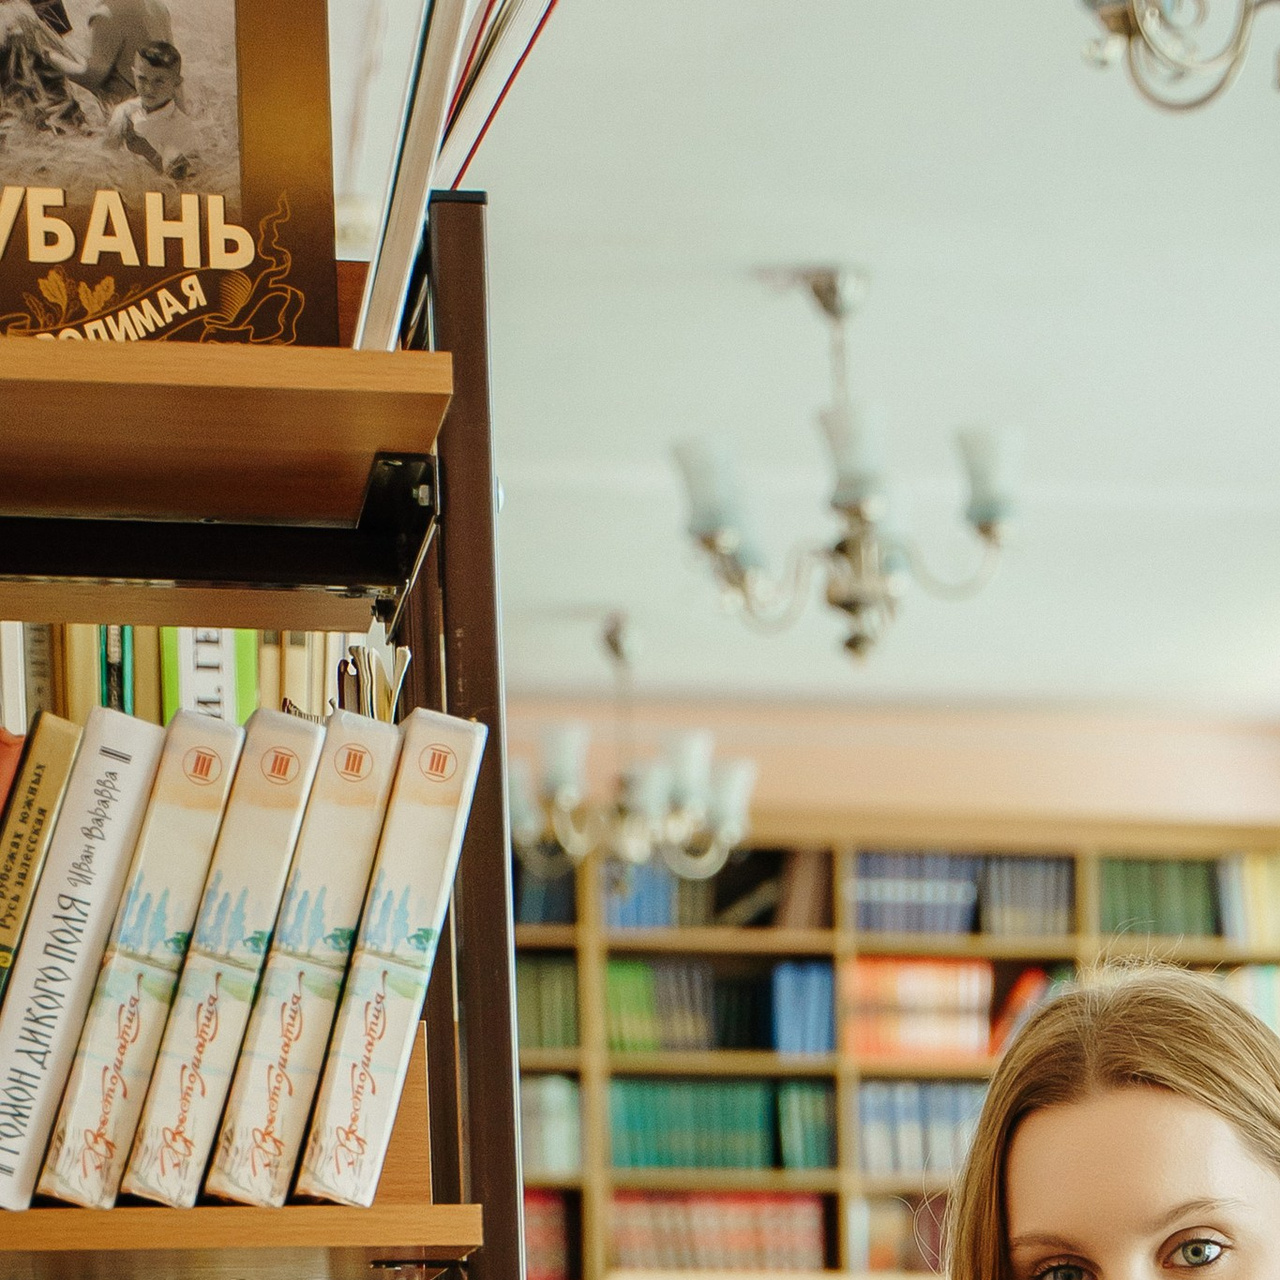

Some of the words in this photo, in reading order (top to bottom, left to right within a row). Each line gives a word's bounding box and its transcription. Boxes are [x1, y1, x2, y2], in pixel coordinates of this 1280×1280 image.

[37, 274, 208, 342] ДИМАЯ
[67, 845, 96, 888] Иван
[14, 965, 72, 1070] ДИКОГО
[43, 893, 91, 964] ПОЛЯ
